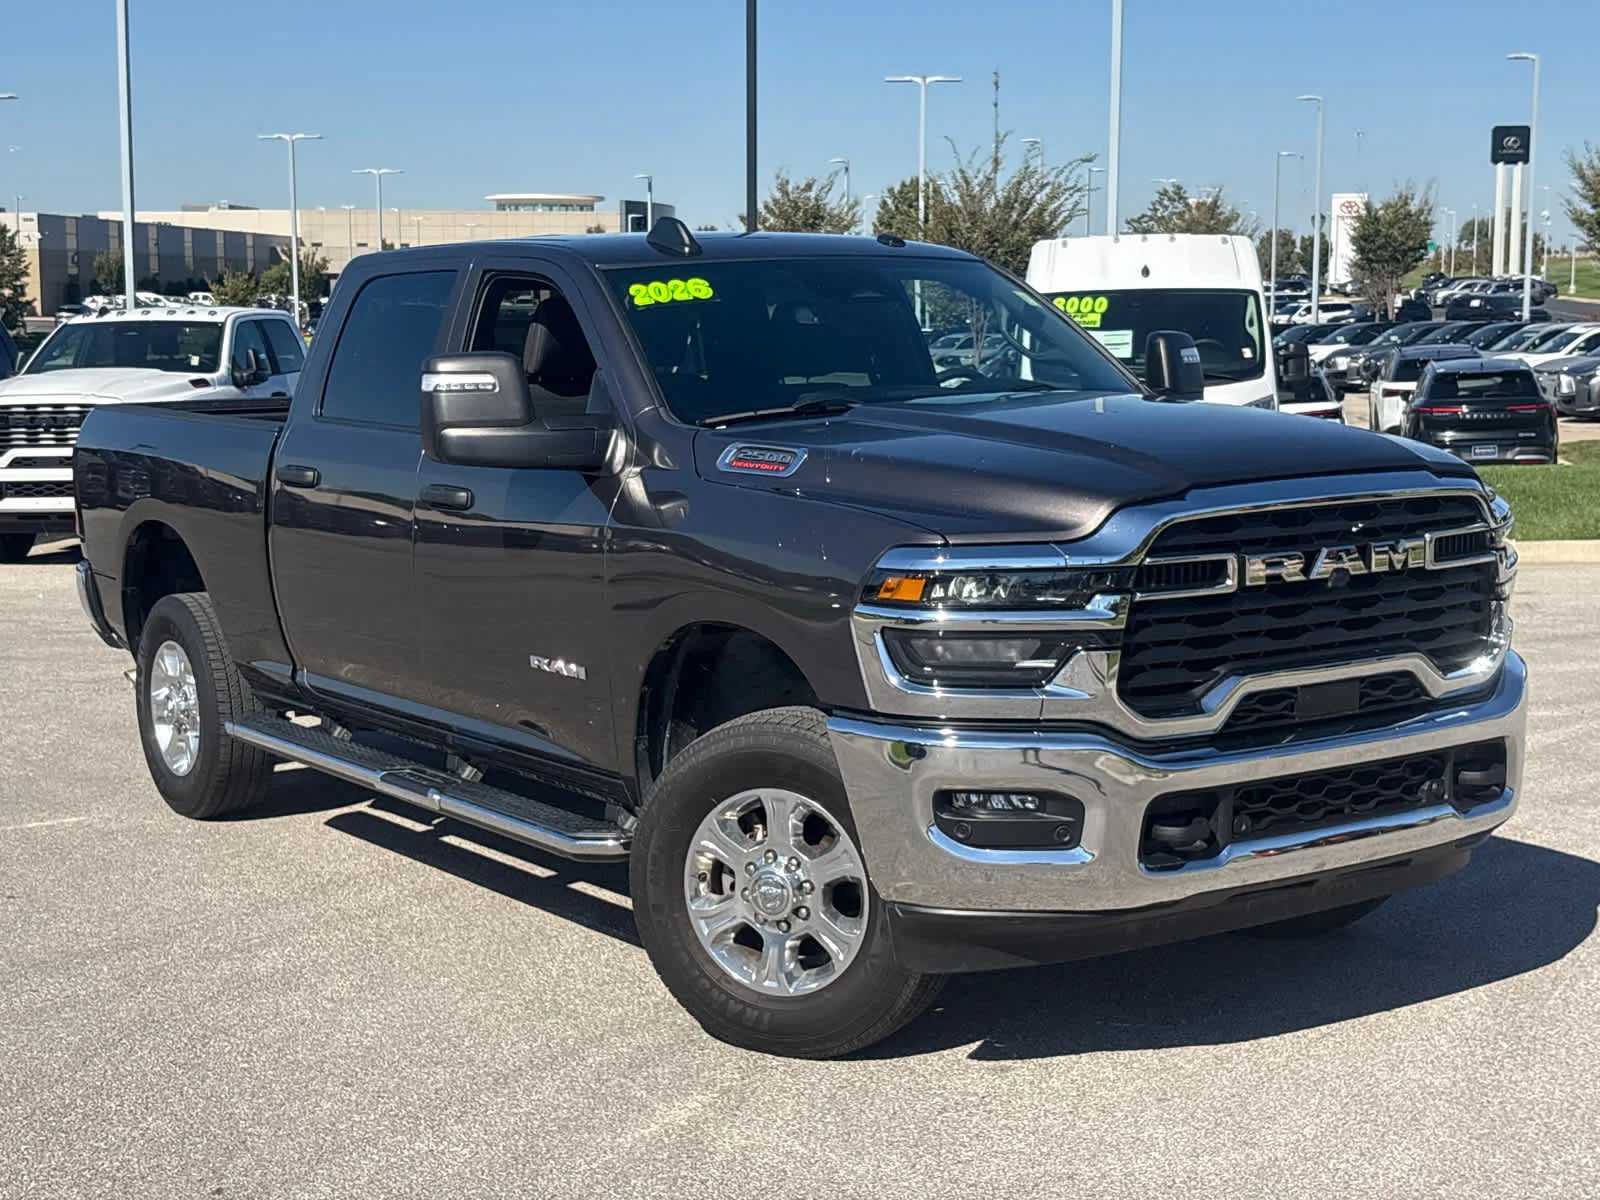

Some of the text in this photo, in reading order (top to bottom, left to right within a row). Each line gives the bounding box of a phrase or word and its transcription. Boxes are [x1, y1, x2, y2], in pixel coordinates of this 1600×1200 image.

[629, 277, 714, 306] 2026
[736, 449, 793, 464] 2500
[1244, 539, 1425, 587] RAM
[529, 654, 587, 680] RAM
